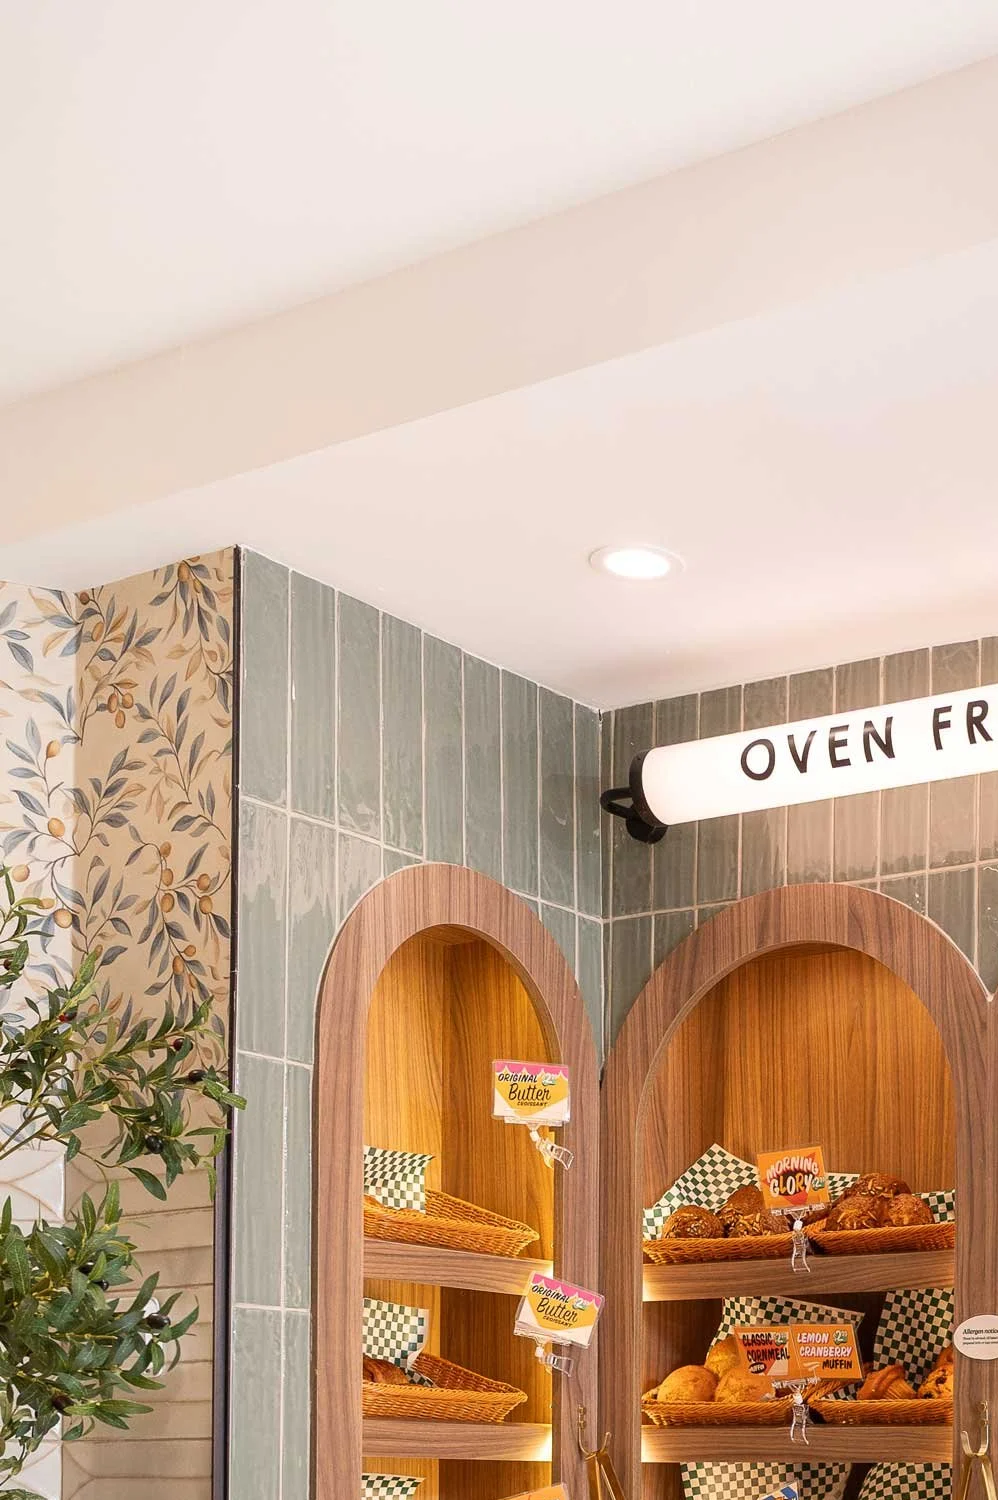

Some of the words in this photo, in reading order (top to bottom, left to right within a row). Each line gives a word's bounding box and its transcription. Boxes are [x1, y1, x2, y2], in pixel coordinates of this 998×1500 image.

[741, 716, 896, 781] OVEN
[498, 1073, 538, 1083] ORIGINAL
[508, 1083, 552, 1101] Butter
[766, 1156, 819, 1184] MORNING
[770, 1172, 812, 1198] GLORY
[532, 1285, 570, 1304] ORIGINAL
[536, 1298, 578, 1322] Butter
[543, 1316, 573, 1328] CROISSANT
[742, 1333, 772, 1347] CLASSIC
[796, 1332, 830, 1344] LEMON
[746, 1348, 790, 1362] CORNMEAL
[799, 1346, 853, 1358] CRANBERRY
[822, 1360, 852, 1370] MUFFIN
